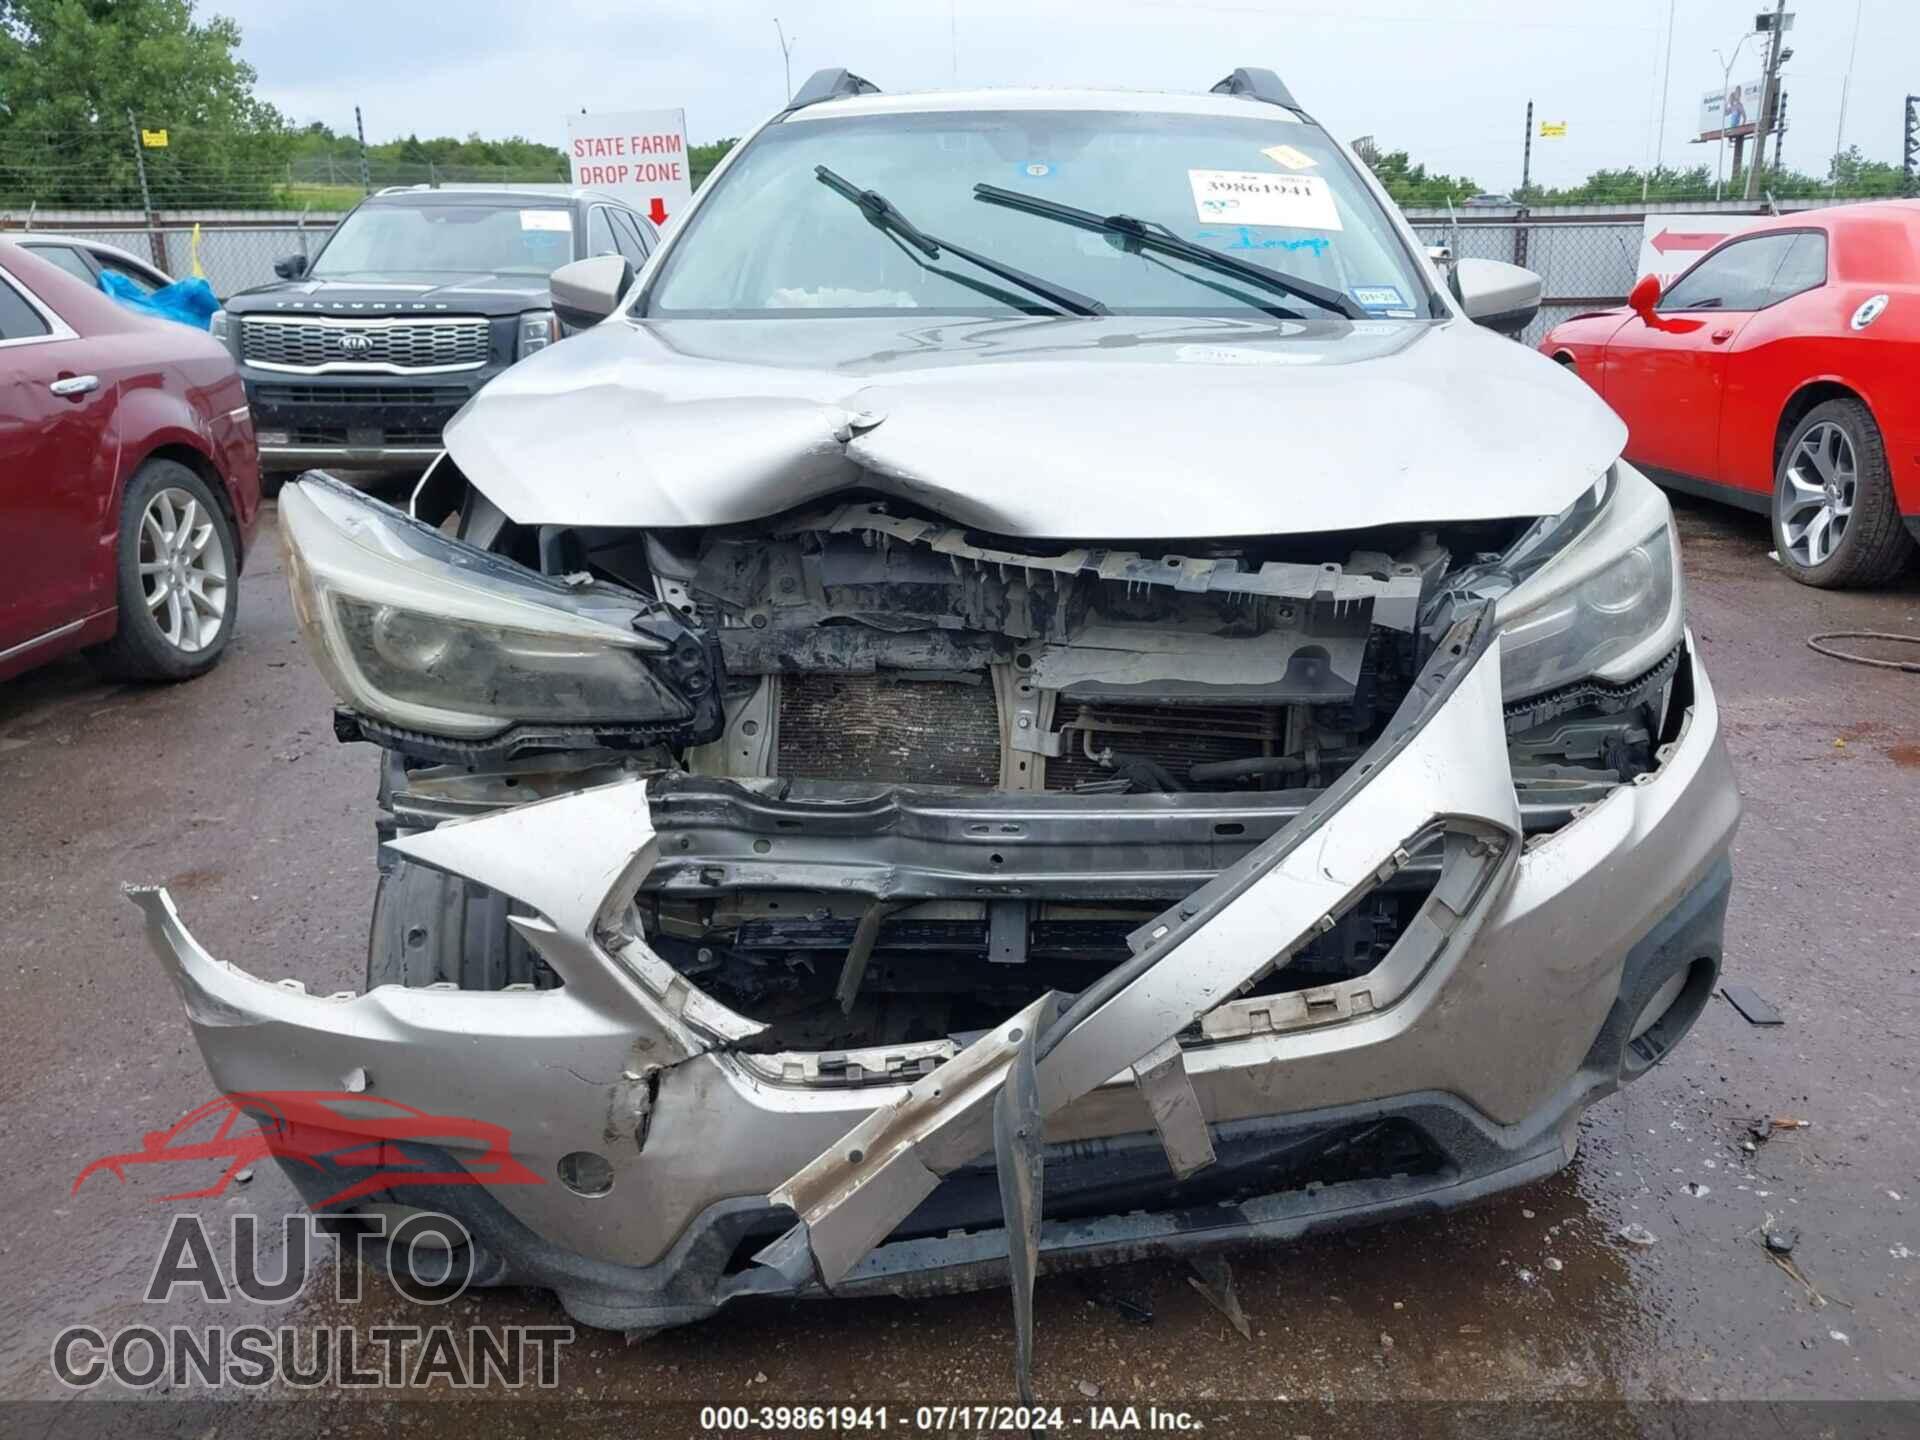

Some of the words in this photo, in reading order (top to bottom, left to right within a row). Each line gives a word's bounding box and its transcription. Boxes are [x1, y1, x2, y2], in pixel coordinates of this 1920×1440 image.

[574, 137, 625, 158] STATE
[631, 134, 682, 155] FARM
[580, 165, 628, 185] DROP
[634, 162, 682, 183] ZONE
[1207, 181, 1313, 197] 39861941
[343, 338, 367, 350] KIA
